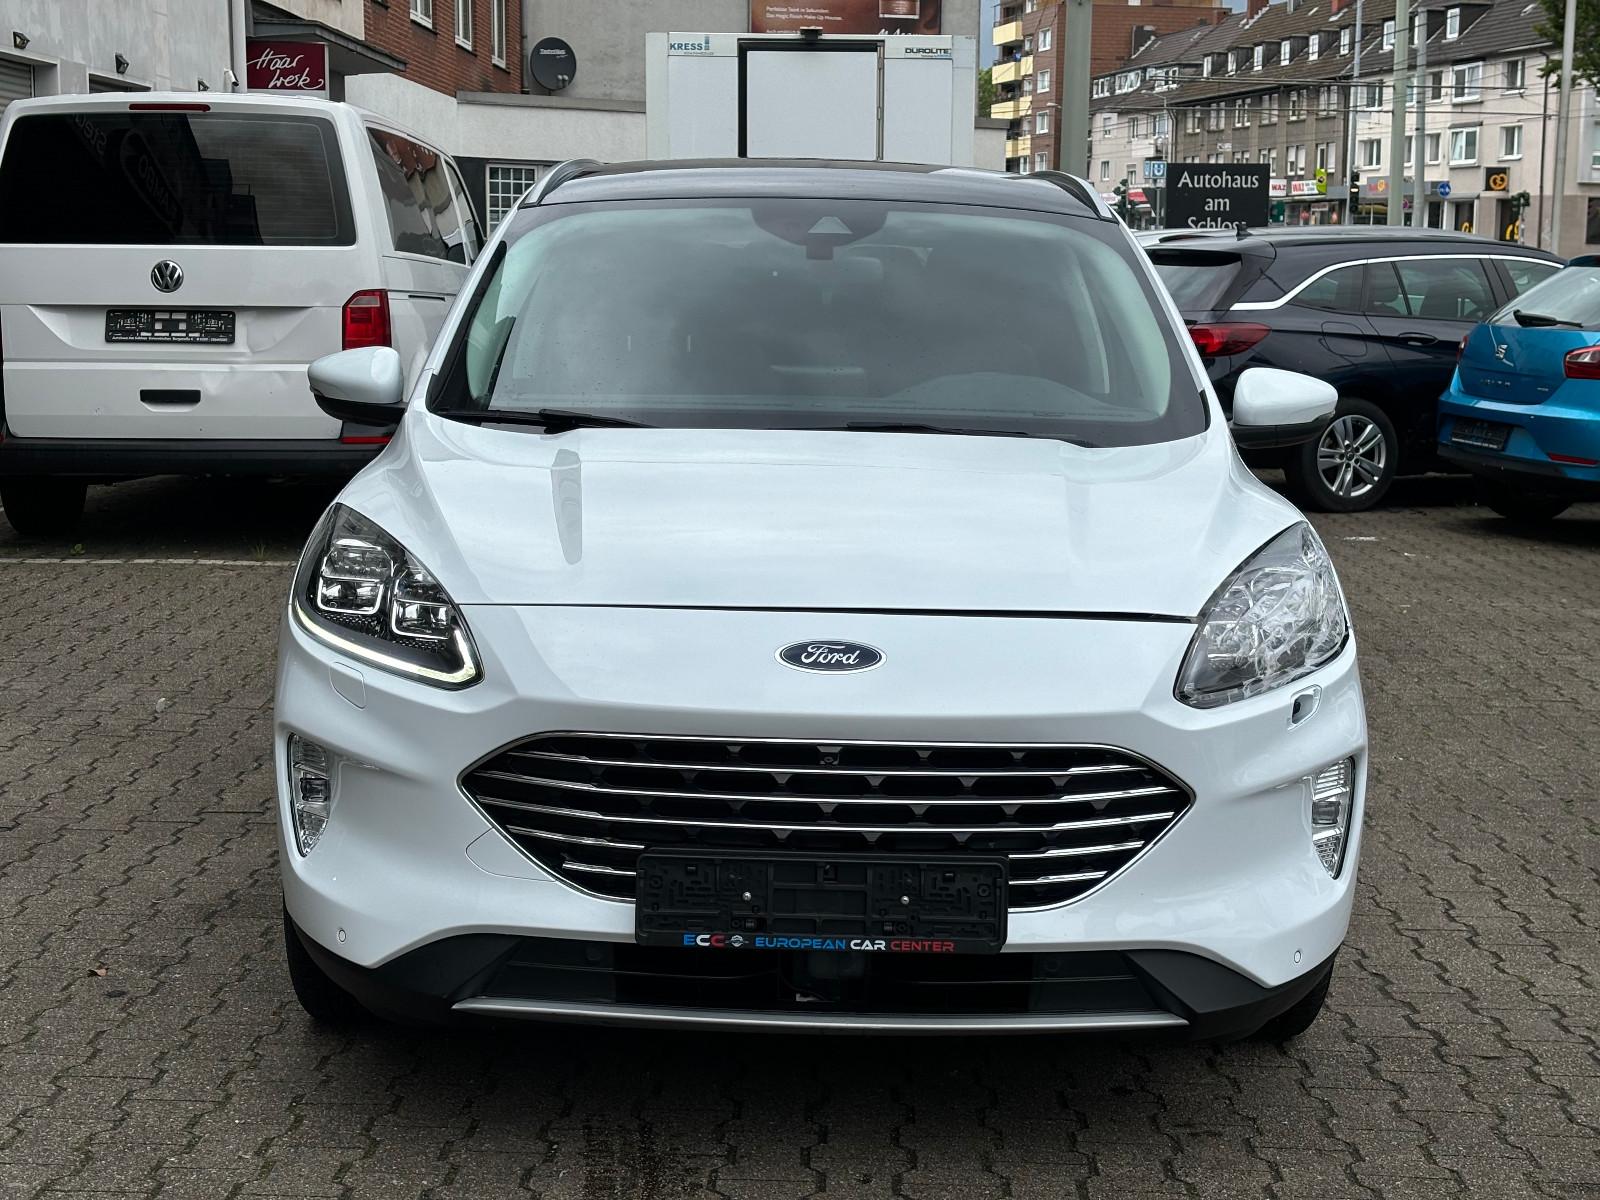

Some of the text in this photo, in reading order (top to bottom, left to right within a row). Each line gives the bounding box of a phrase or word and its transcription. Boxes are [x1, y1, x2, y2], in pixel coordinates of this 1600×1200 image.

[247, 48, 304, 70] Haar
[1154, 164, 1164, 176] U
[1177, 171, 1259, 188] Autohaus
[1204, 198, 1230, 211] am
[1187, 217, 1247, 229] Schlos
[801, 644, 860, 664] Ford
[684, 934, 954, 952] ECC EUROPEAN CAR CENTER
